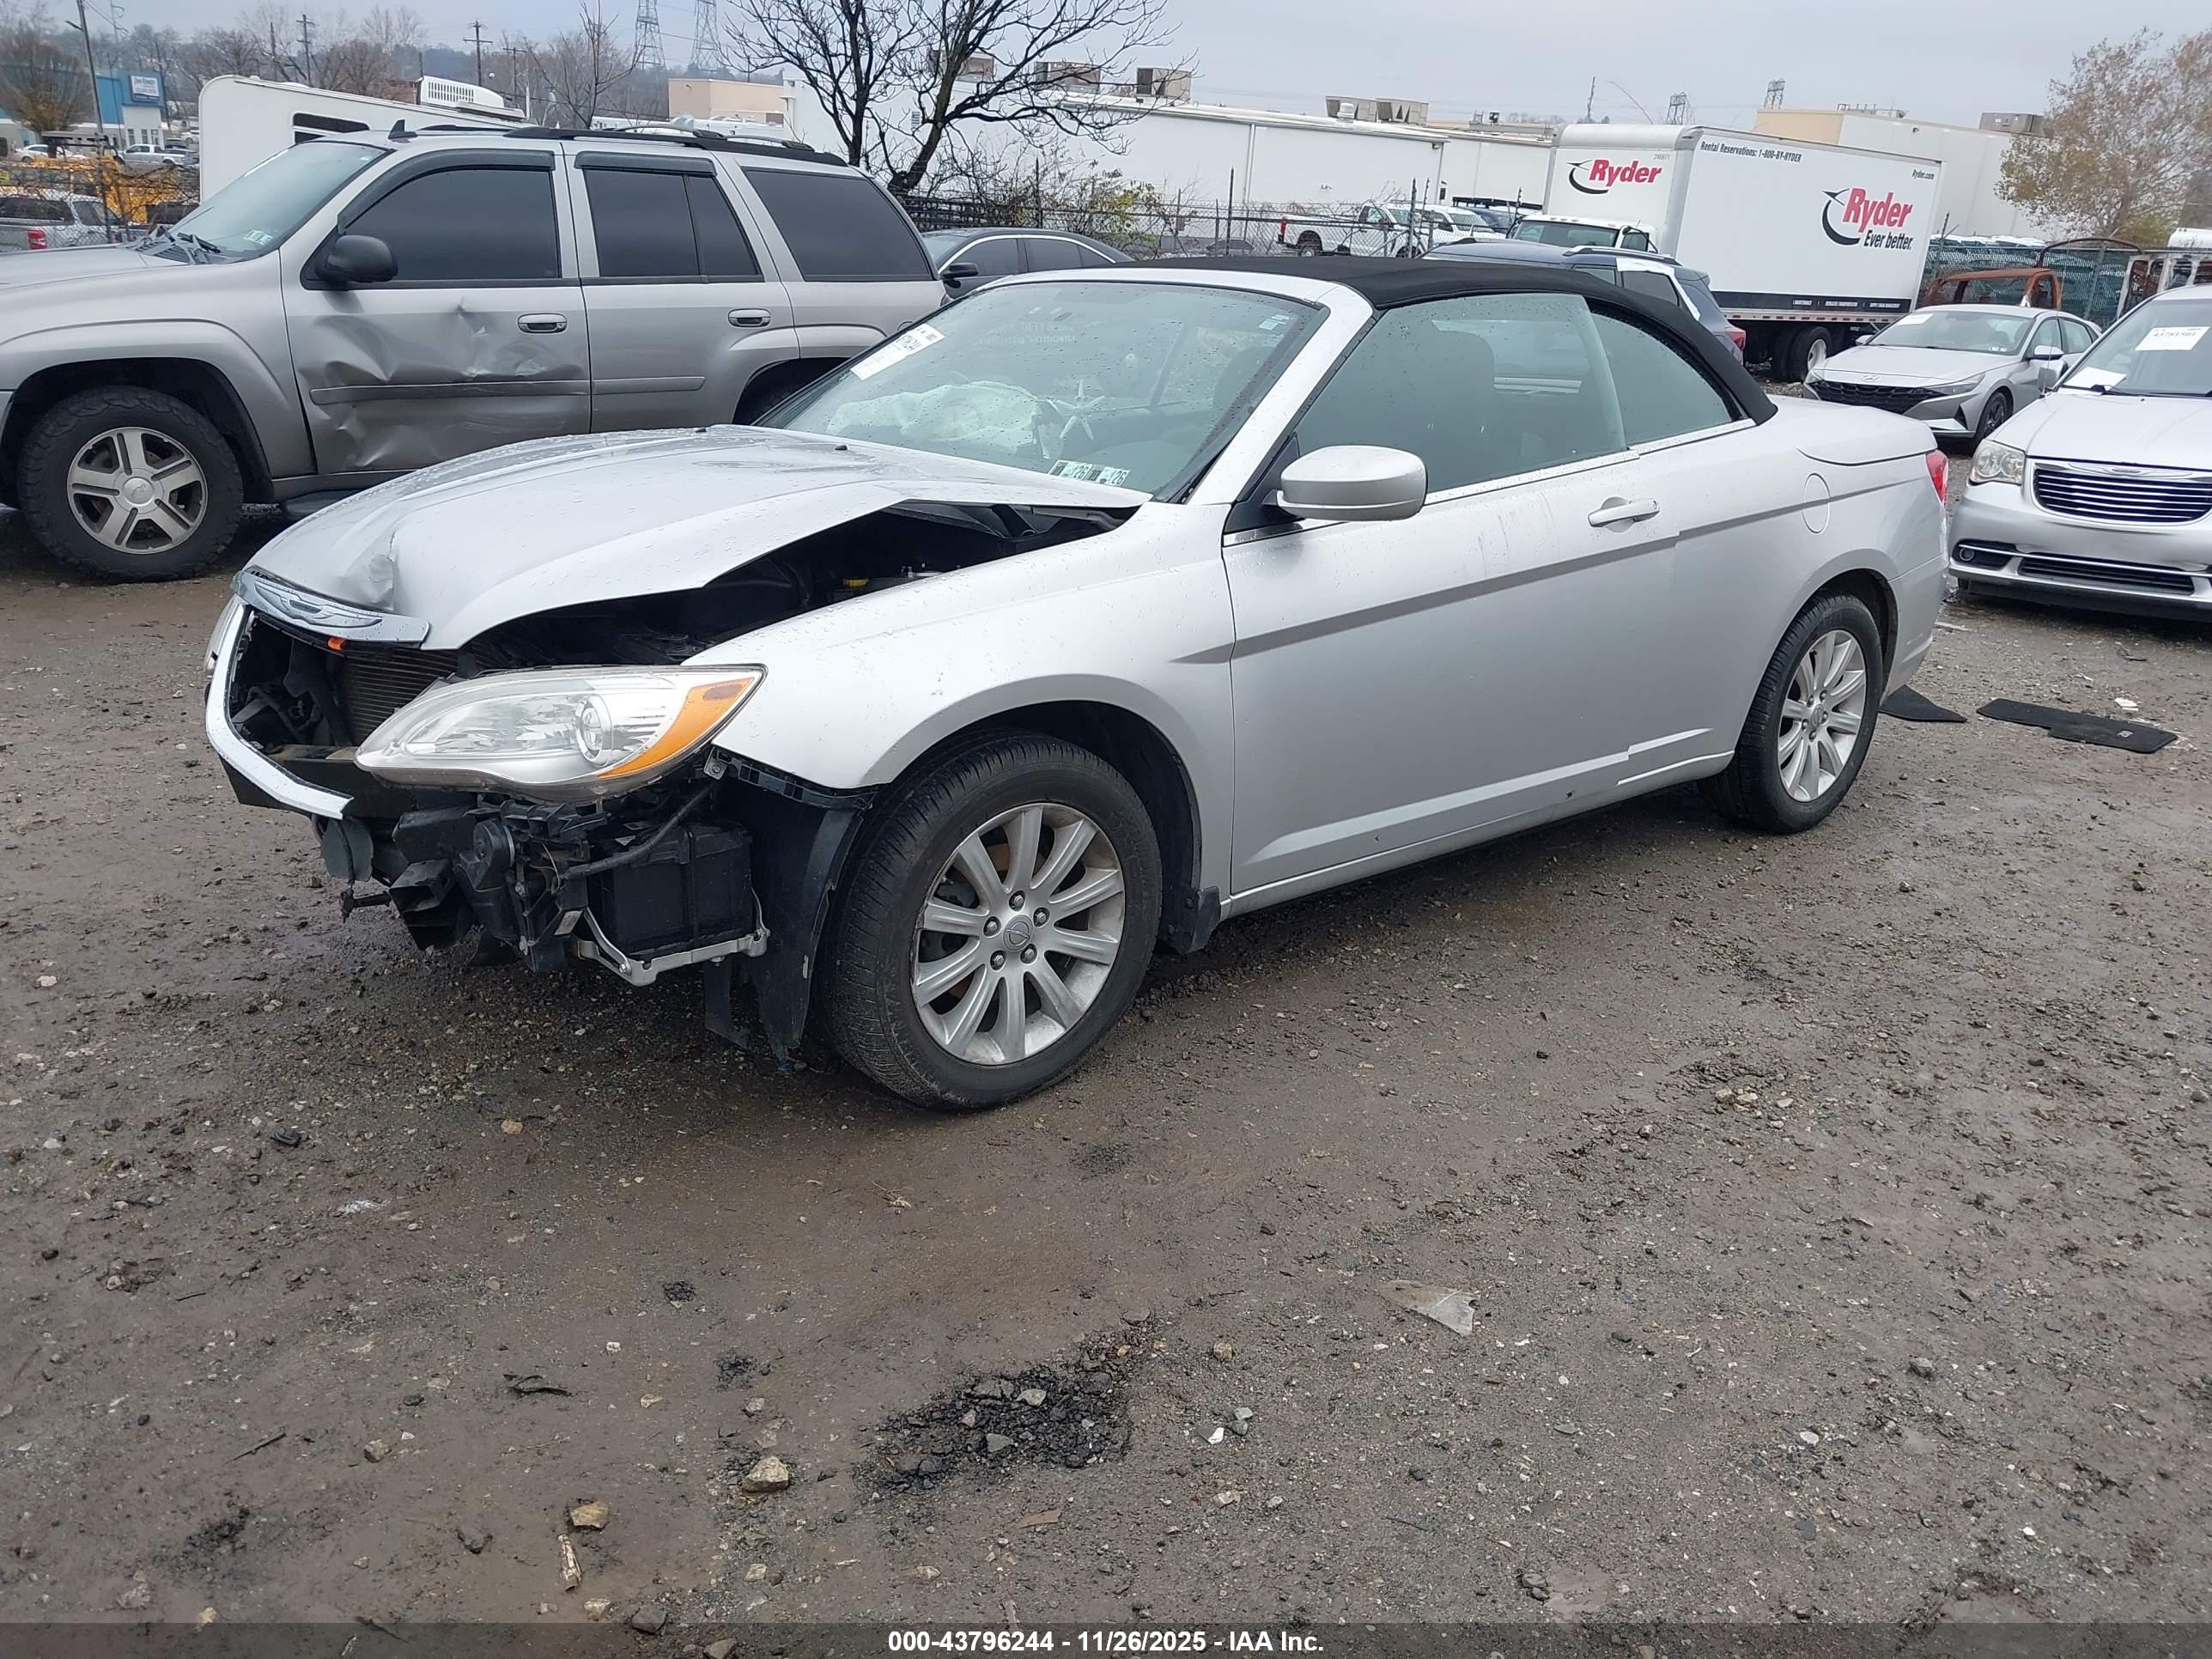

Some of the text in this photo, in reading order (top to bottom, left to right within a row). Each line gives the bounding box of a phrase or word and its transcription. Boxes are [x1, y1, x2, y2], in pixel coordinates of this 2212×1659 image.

[1700, 141, 1802, 163] Rental Reservations: 1-800-BY-RYDER
[1589, 160, 1662, 186] Ryder
[1911, 169, 1935, 179] Ryder.com
[1842, 188, 1913, 233] Ryder
[1863, 229, 1885, 248] Ever
